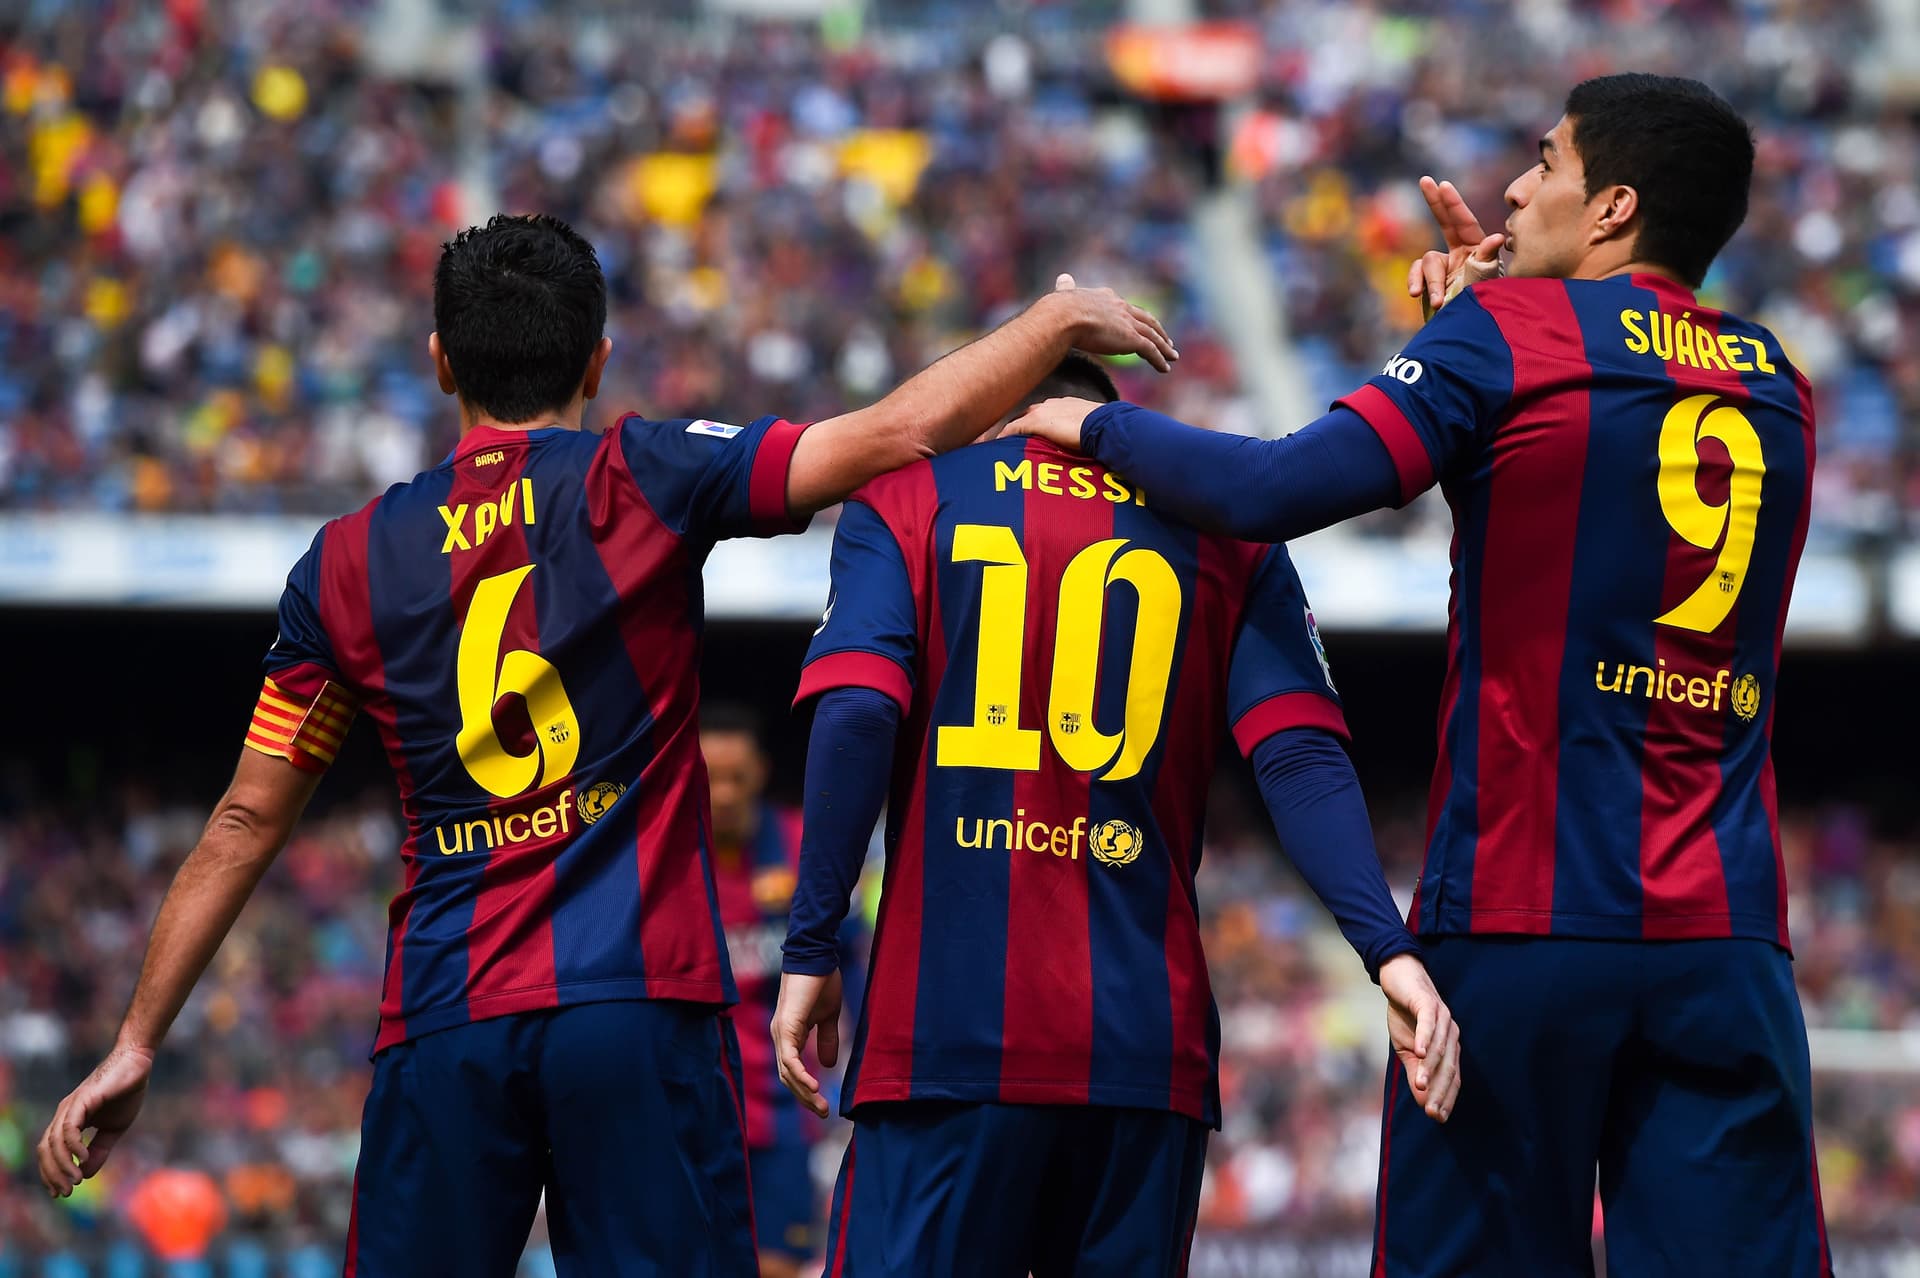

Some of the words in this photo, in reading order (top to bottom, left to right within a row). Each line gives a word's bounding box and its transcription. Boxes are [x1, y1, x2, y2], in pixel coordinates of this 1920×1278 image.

[1382, 353, 1423, 385] KO
[1620, 308, 1776, 375] SUÁREZ
[475, 450, 504, 467] BARÇA
[437, 477, 535, 554] XAVI
[1652, 393, 1766, 633] 9
[456, 563, 580, 798] 6
[936, 523, 1182, 781] 10
[1596, 658, 1730, 711] unicef
[435, 789, 572, 856] unicef
[956, 808, 1087, 860] unicef
